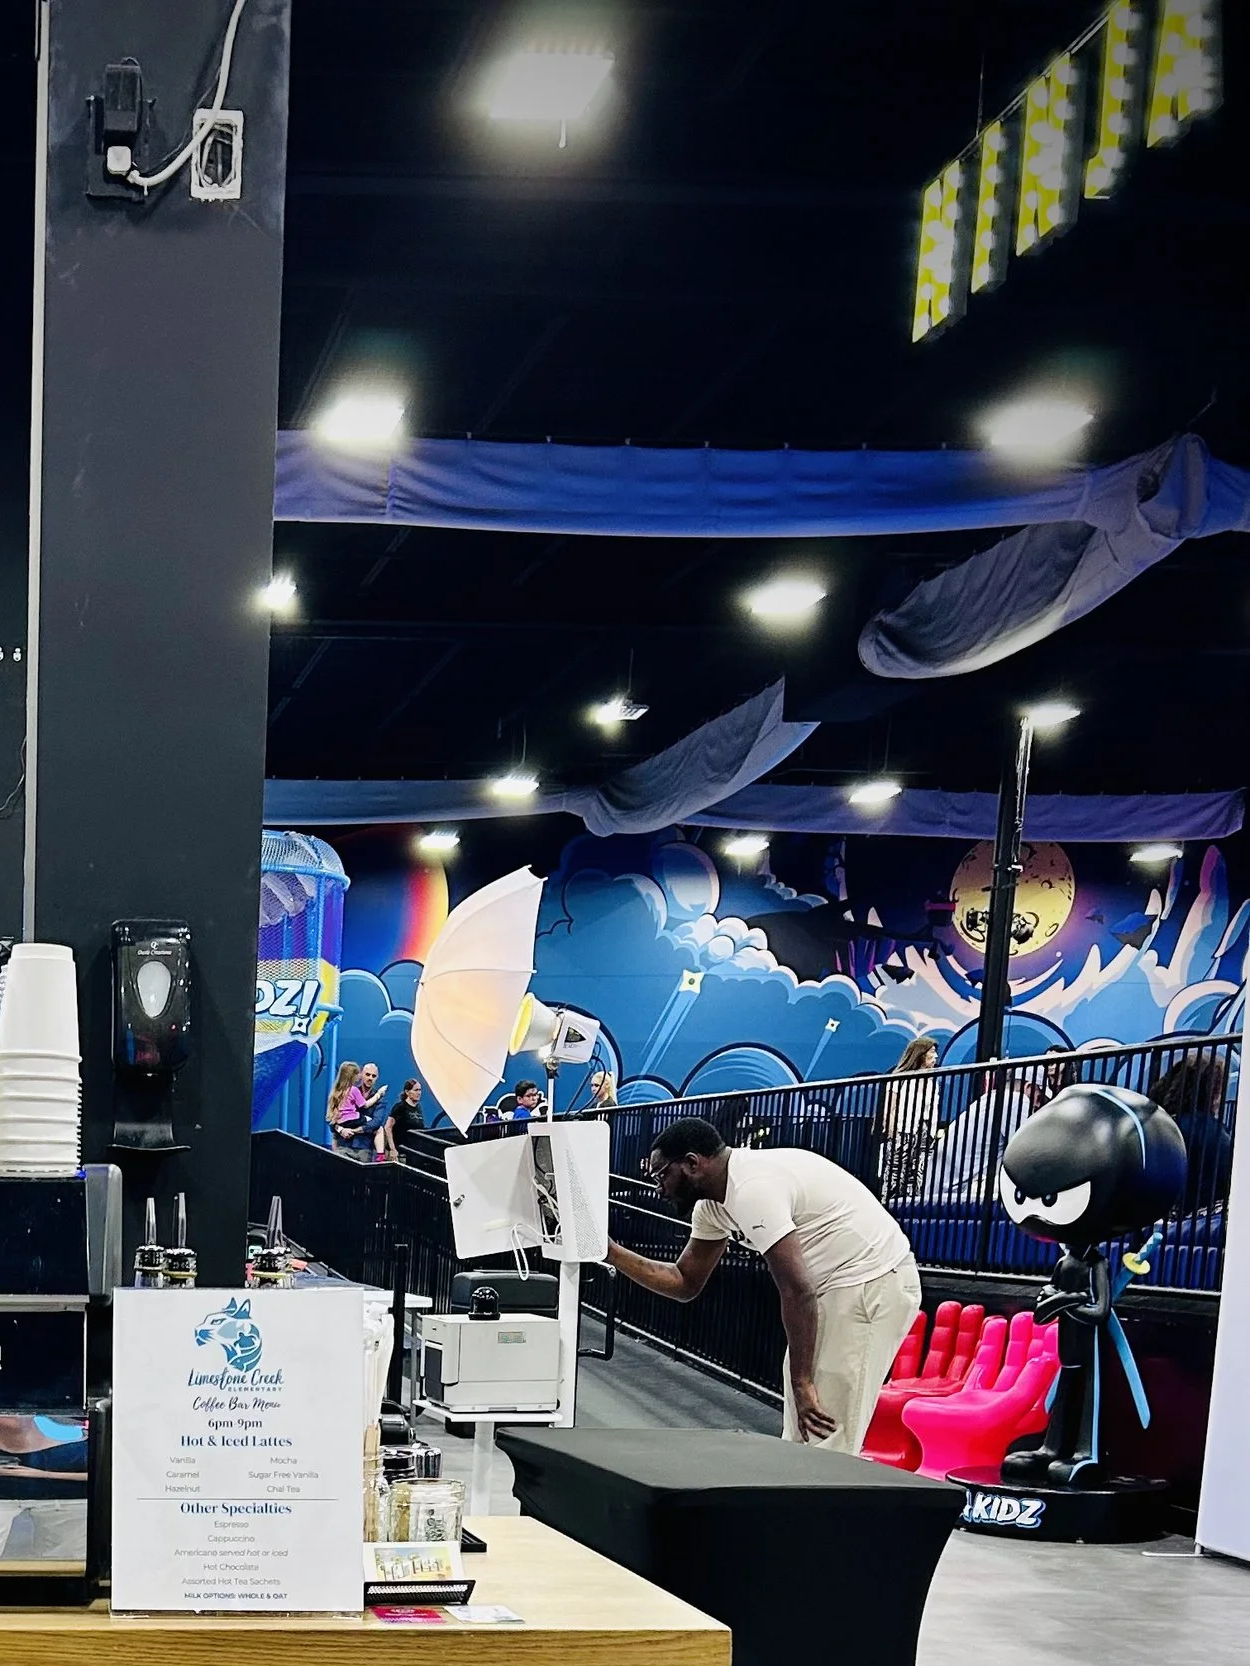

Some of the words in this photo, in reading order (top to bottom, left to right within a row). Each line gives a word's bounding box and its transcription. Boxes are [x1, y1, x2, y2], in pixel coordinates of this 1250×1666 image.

[255, 979, 320, 1034] DZ!
[188, 1367, 247, 1390] Limestone
[251, 1368, 284, 1386] Creek
[192, 1396, 226, 1412] Coffee
[229, 1396, 250, 1411] Bar
[252, 1397, 282, 1412] Menu
[181, 1435, 203, 1447] Hot
[207, 1435, 217, 1447] &
[221, 1435, 248, 1447] Iced
[252, 1435, 292, 1447] Lattes
[169, 1456, 196, 1464] Vanilla
[270, 1456, 297, 1465] Mocha
[165, 1470, 200, 1479] Caramel
[248, 1470, 271, 1480] Sugar
[273, 1470, 291, 1479] Free
[293, 1470, 319, 1479] Vanilla
[164, 1484, 201, 1493] Hazelnut
[266, 1484, 284, 1493] Chai
[286, 1484, 300, 1493] Tea
[180, 1502, 219, 1514] Other
[221, 1502, 292, 1517] Specialties
[972, 1491, 1047, 1528] KIDZ
[214, 1520, 249, 1529] Espresso
[207, 1534, 256, 1543] Cappuccino
[174, 1548, 218, 1557] Americano
[219, 1548, 245, 1557] served
[246, 1548, 260, 1557] hot
[261, 1549, 270, 1557] or
[271, 1548, 289, 1557] iced
[203, 1563, 218, 1571] Hot
[219, 1562, 259, 1571] Chocolate
[181, 1577, 216, 1586] Assorted
[217, 1577, 233, 1586] Hot
[234, 1577, 248, 1586] Tea
[249, 1577, 281, 1586] Sachets
[184, 1592, 202, 1600] MILK
[237, 1592, 265, 1600] WHOLE
[265, 1592, 272, 1600] &
[272, 1592, 288, 1600] OAT
